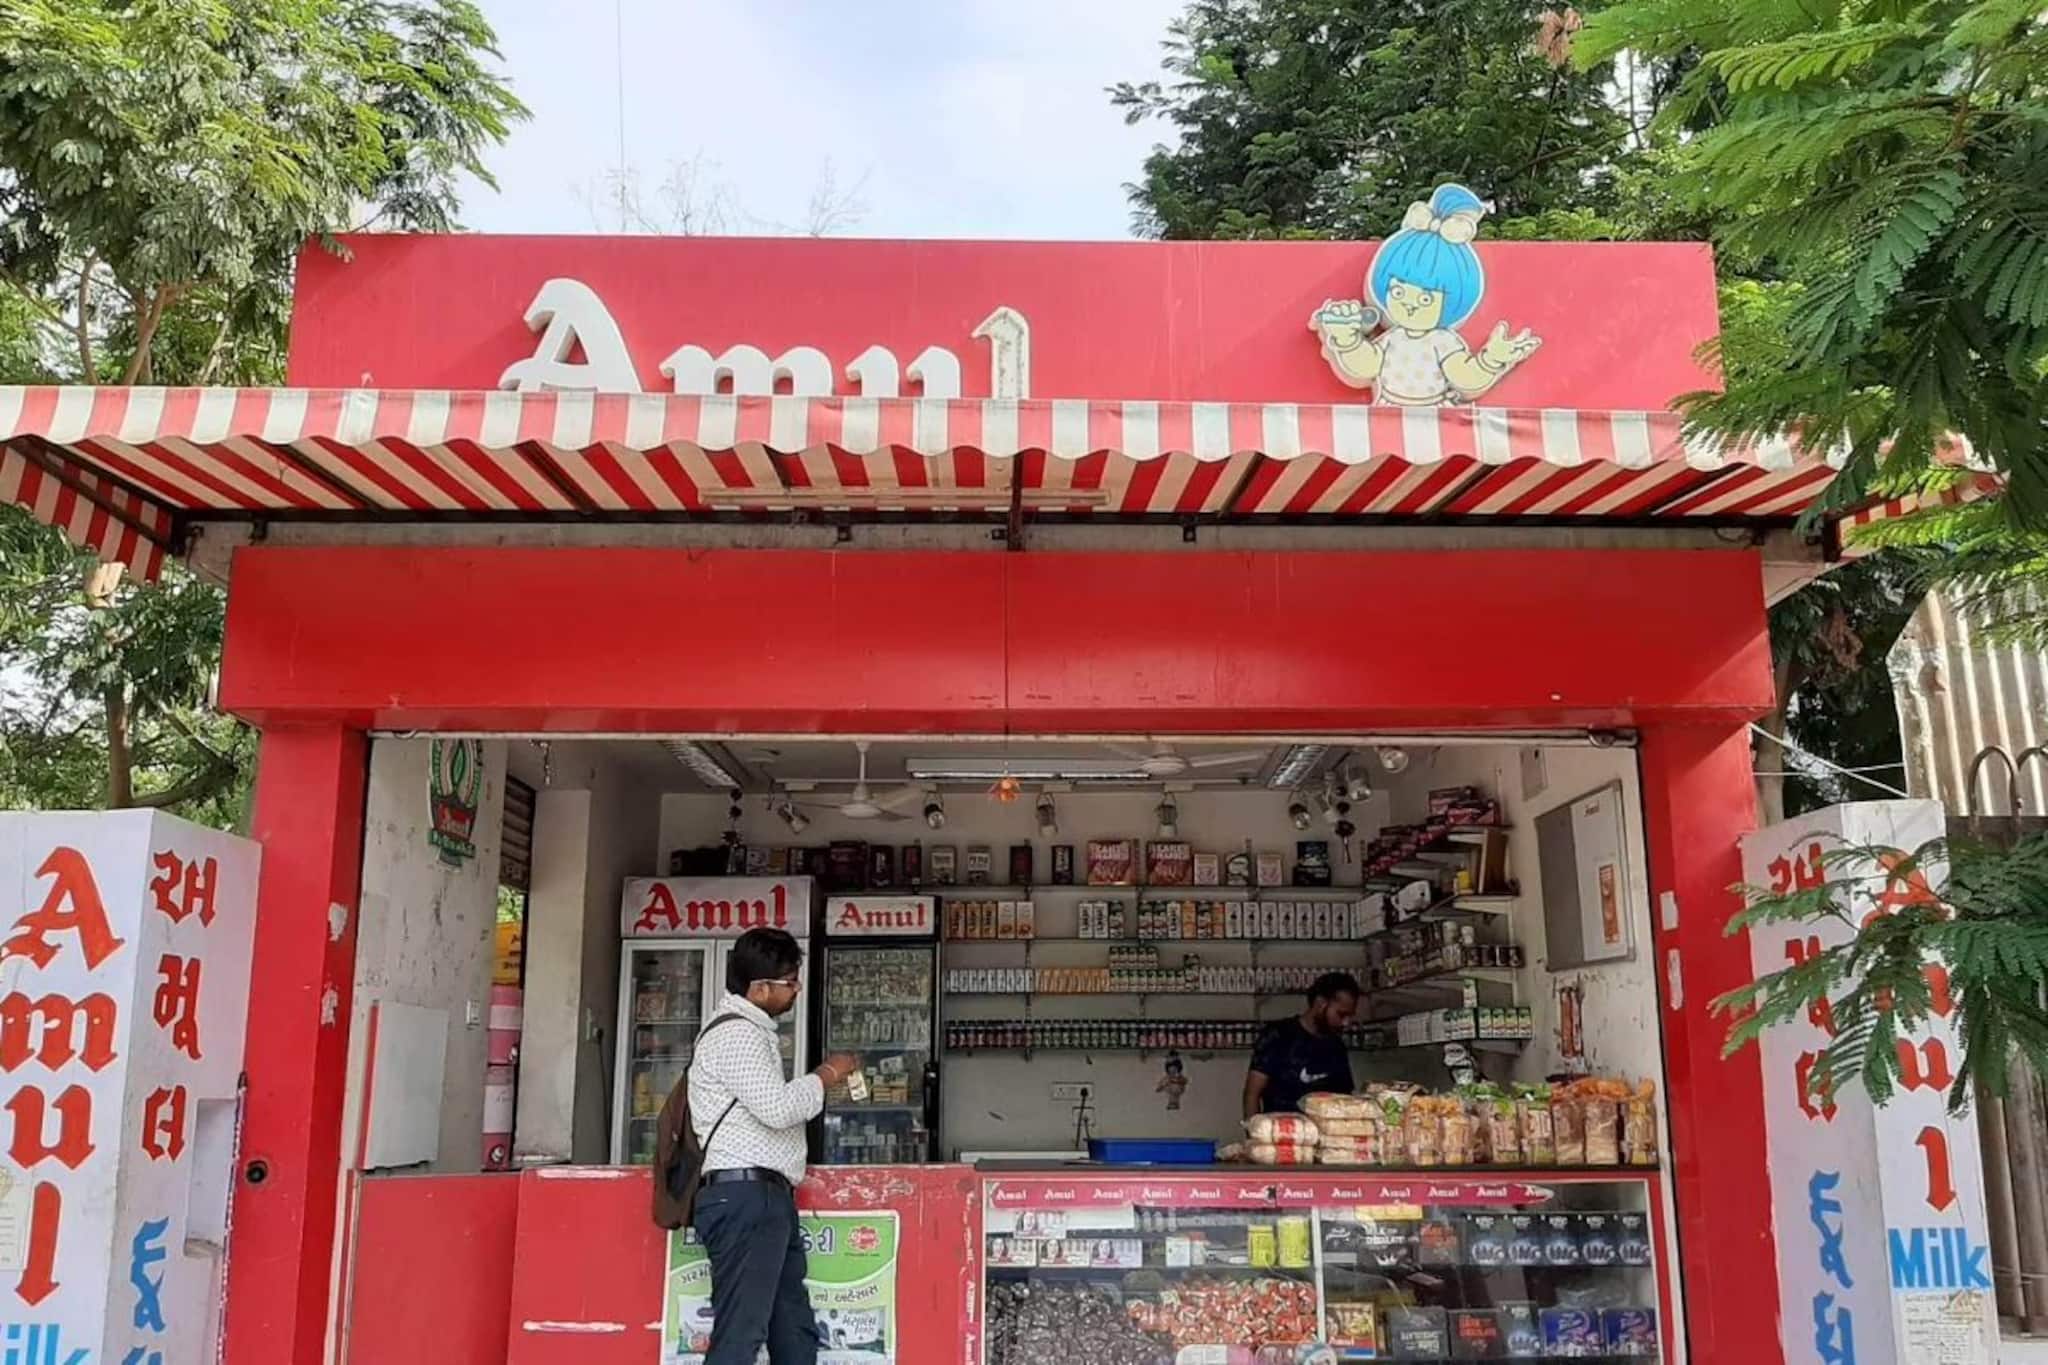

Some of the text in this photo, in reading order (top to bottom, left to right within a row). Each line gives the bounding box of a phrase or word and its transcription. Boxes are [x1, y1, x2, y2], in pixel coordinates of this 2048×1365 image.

[634, 882, 788, 933] Amul
[835, 902, 927, 929] Amul
[0, 846, 125, 1306] Amul
[1889, 1227, 1992, 1288] Milk
